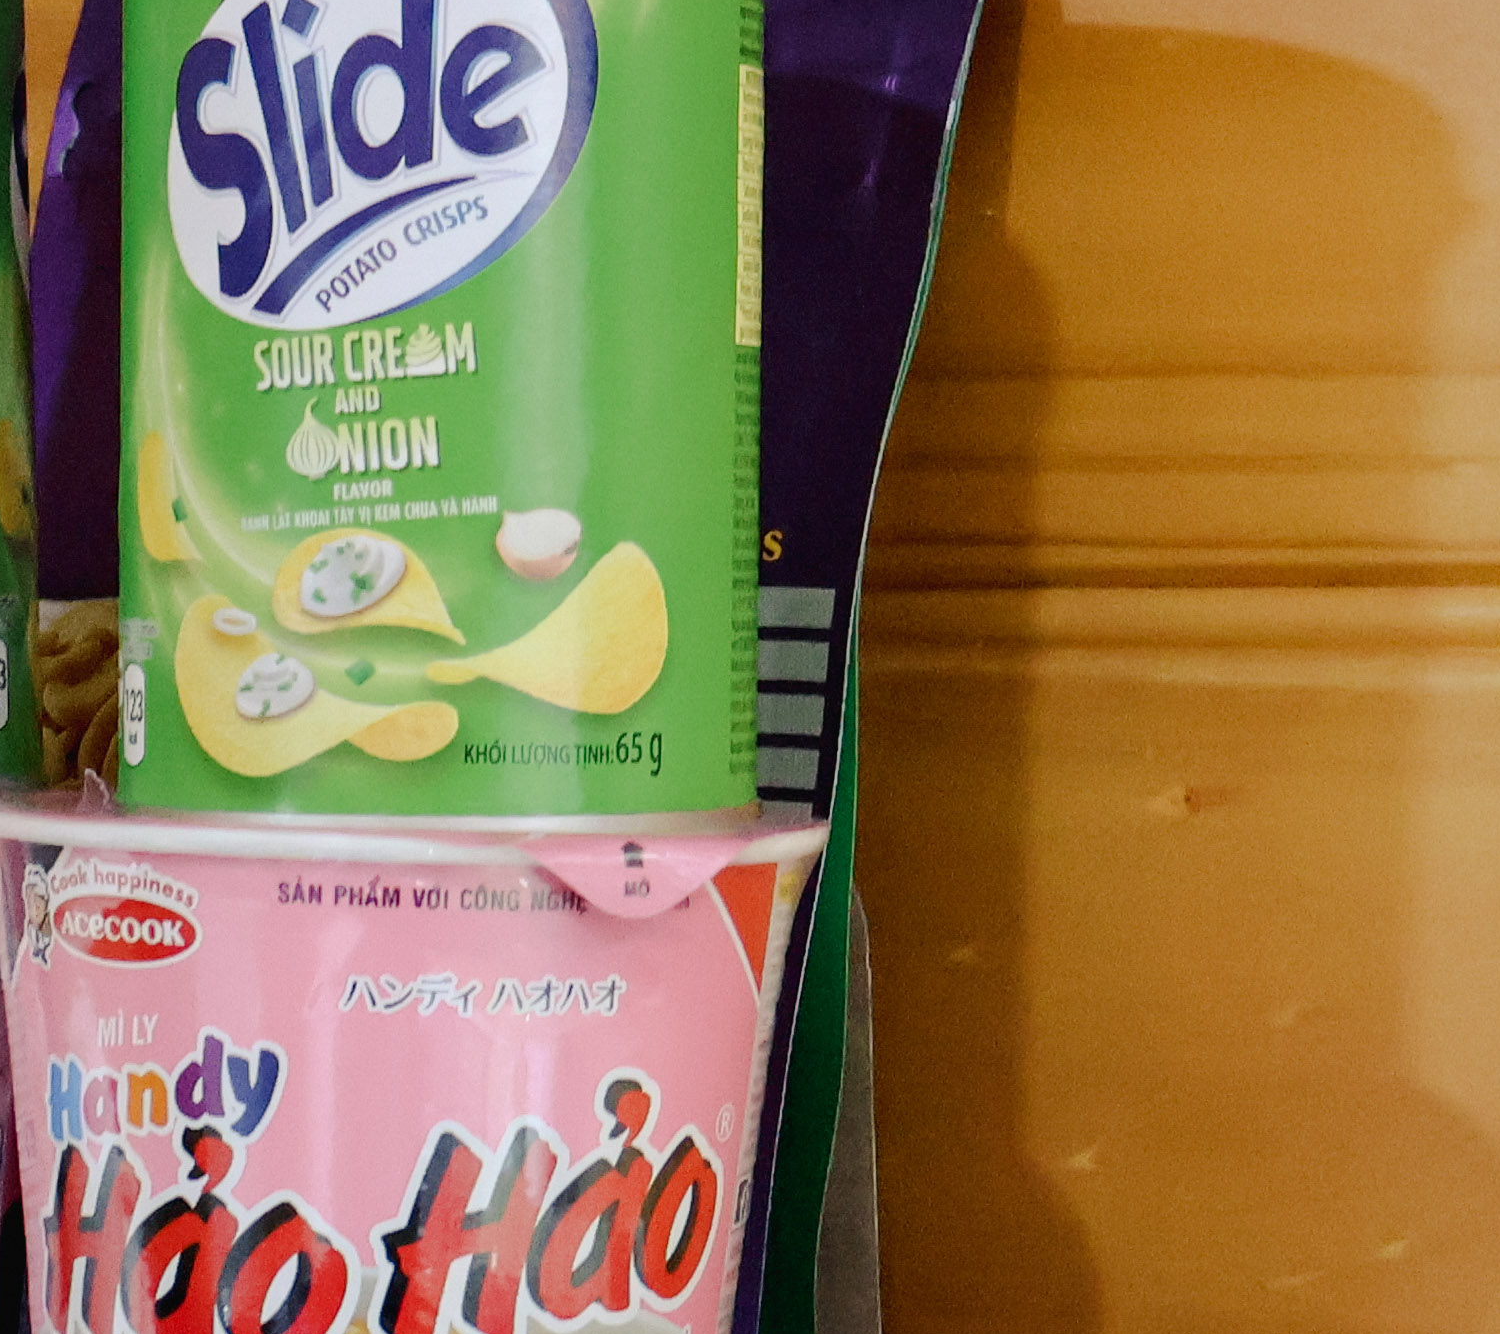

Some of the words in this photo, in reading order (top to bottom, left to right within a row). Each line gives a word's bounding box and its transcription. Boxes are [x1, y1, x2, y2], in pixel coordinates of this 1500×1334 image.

[314, 237, 398, 314] POTATO
[402, 194, 490, 247] CRISPS
[253, 333, 336, 392] SOUR
[335, 385, 381, 415] AND
[332, 478, 395, 501] FLAVOR
[374, 503, 401, 523] KEM
[405, 500, 438, 519] CHUA
[124, 688, 144, 723] 123
[464, 739, 508, 766] KHỐI
[51, 866, 88, 895] Cook
[93, 862, 194, 908] happiness
[277, 875, 323, 905] SẢN
[334, 874, 401, 910] PHẨM
[460, 883, 520, 912] CÔNG
[490, 975, 625, 1014] ハオハオ
[98, 1008, 125, 1047] MÌ
[131, 1013, 159, 1046] LY
[48, 1034, 280, 1142] Handy
